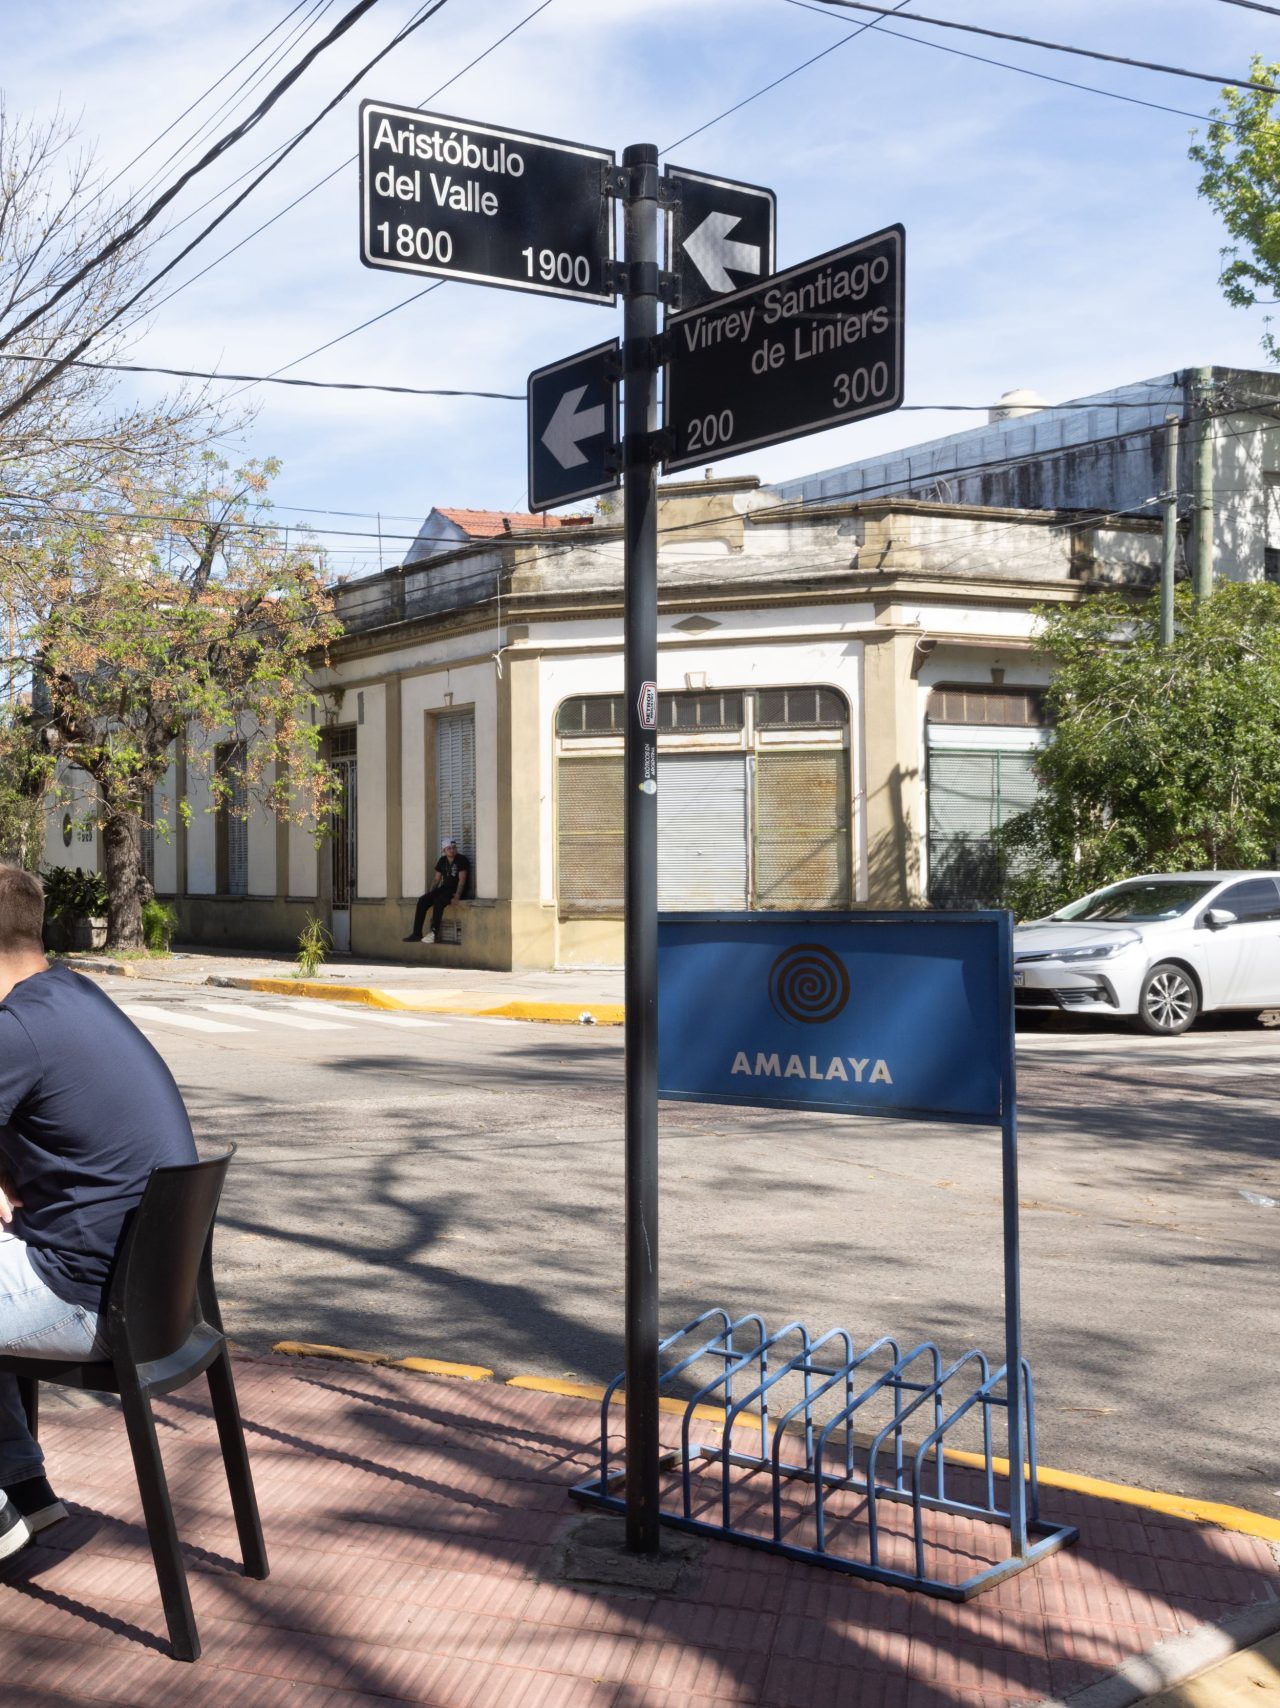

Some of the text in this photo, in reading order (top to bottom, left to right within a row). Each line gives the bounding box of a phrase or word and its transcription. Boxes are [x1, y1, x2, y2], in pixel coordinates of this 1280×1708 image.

[373, 118, 525, 177] Aristóbulo
[375, 165, 499, 216] del Valle
[377, 221, 453, 263] 1800
[522, 246, 590, 287] 1900
[683, 256, 889, 352] Virrey Santiago
[751, 305, 889, 375] de Liniers
[832, 361, 889, 409] 300
[687, 409, 734, 451] 200
[731, 1051, 894, 1085] AMALAYA
